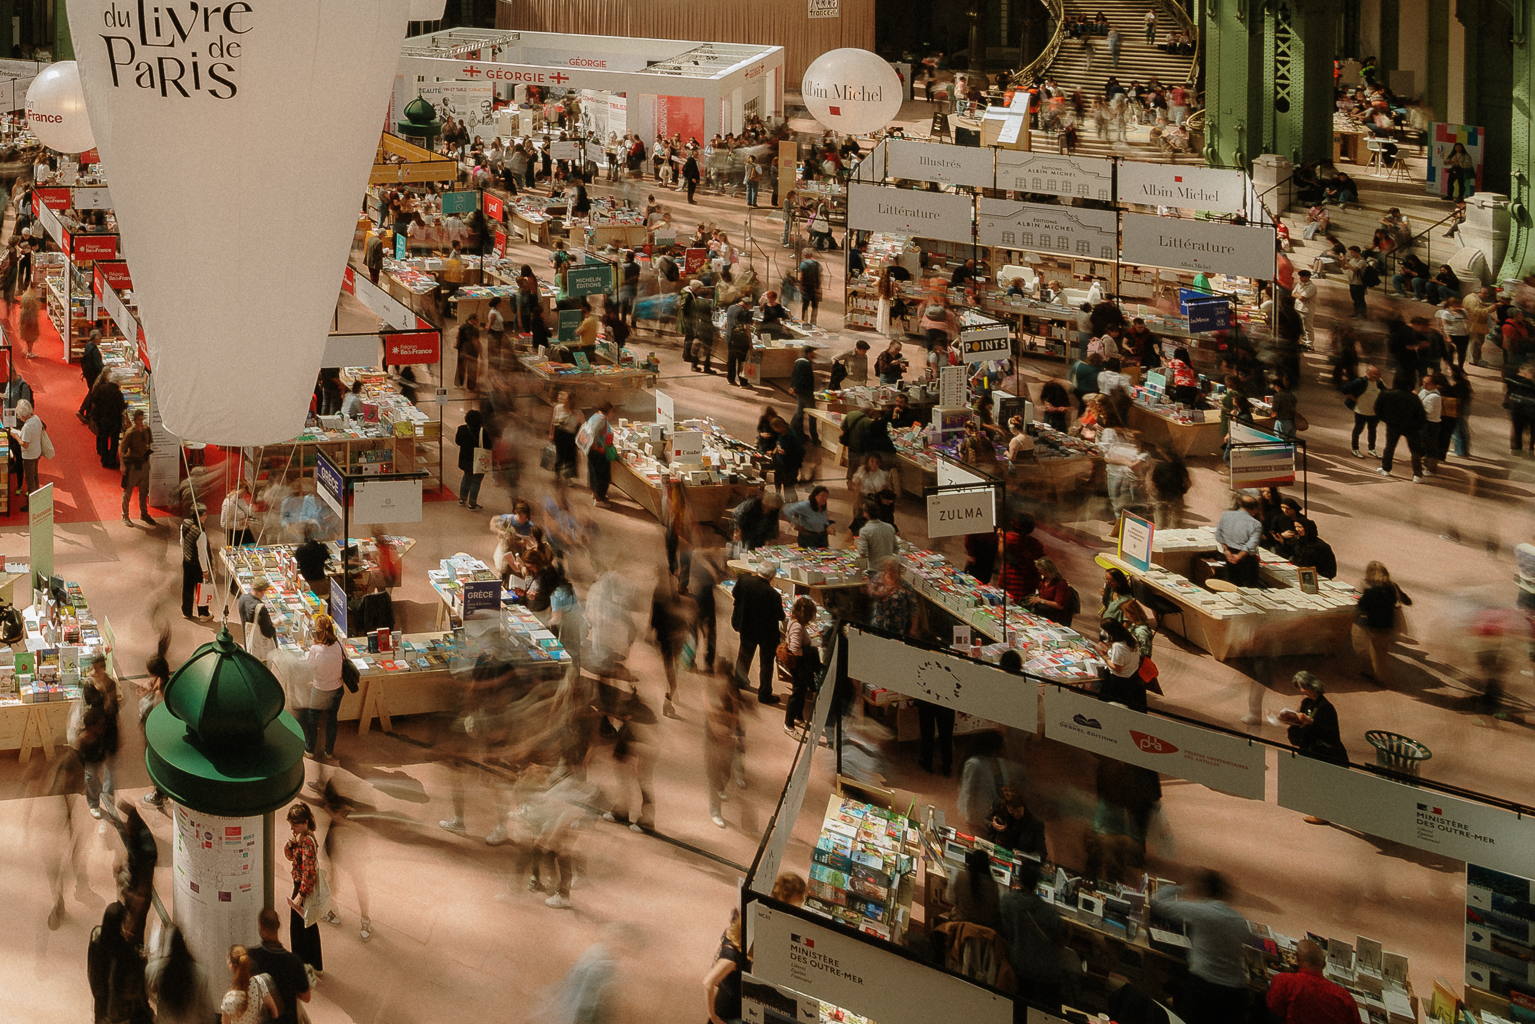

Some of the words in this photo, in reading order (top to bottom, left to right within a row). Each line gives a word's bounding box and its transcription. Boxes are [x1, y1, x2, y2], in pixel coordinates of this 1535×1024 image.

[104, 2, 130, 28] du
[208, 35, 241, 58] de
[568, 57, 606, 68] GÉORGIE
[0, 70, 22, 79] Trédaniel
[485, 68, 544, 83] GÉORGIE
[832, 84, 882, 102] Michel
[919, 156, 961, 169] Illustrés
[1027, 168, 1046, 176] ALBIN
[1051, 170, 1077, 179] MICHEL
[1139, 184, 1174, 199] Albin
[1177, 186, 1219, 203] Michel
[488, 203, 497, 212] puf
[878, 204, 941, 221] Littérature
[1016, 220, 1040, 230] ALBIN
[1044, 222, 1074, 233] MICHEL
[1033, 218, 1057, 226] ÉDITIONS
[1158, 236, 1235, 256] Littérature
[965, 339, 1006, 352] POINTS
[321, 467, 339, 493] GRÈCE
[939, 507, 983, 521] ZULMA
[467, 591, 493, 599] GRÈCE
[1059, 722, 1085, 734] DESNEL
[1086, 729, 1117, 744] ÉDITIONS
[1184, 749, 1205, 759] PRESSES
[1206, 754, 1248, 770] UNIVERSITAIRES
[1195, 756, 1219, 767] ANTILLES
[1416, 811, 1469, 831] MINISTÈRE
[1416, 818, 1435, 829] DES
[1437, 824, 1495, 845] OUTRE-MER
[791, 944, 840, 968] MINISTÈRE
[791, 962, 806, 970] Liberté
[791, 953, 807, 965] DES
[809, 959, 864, 985] OUTRE-MER
[791, 973, 812, 984] Fraternité
